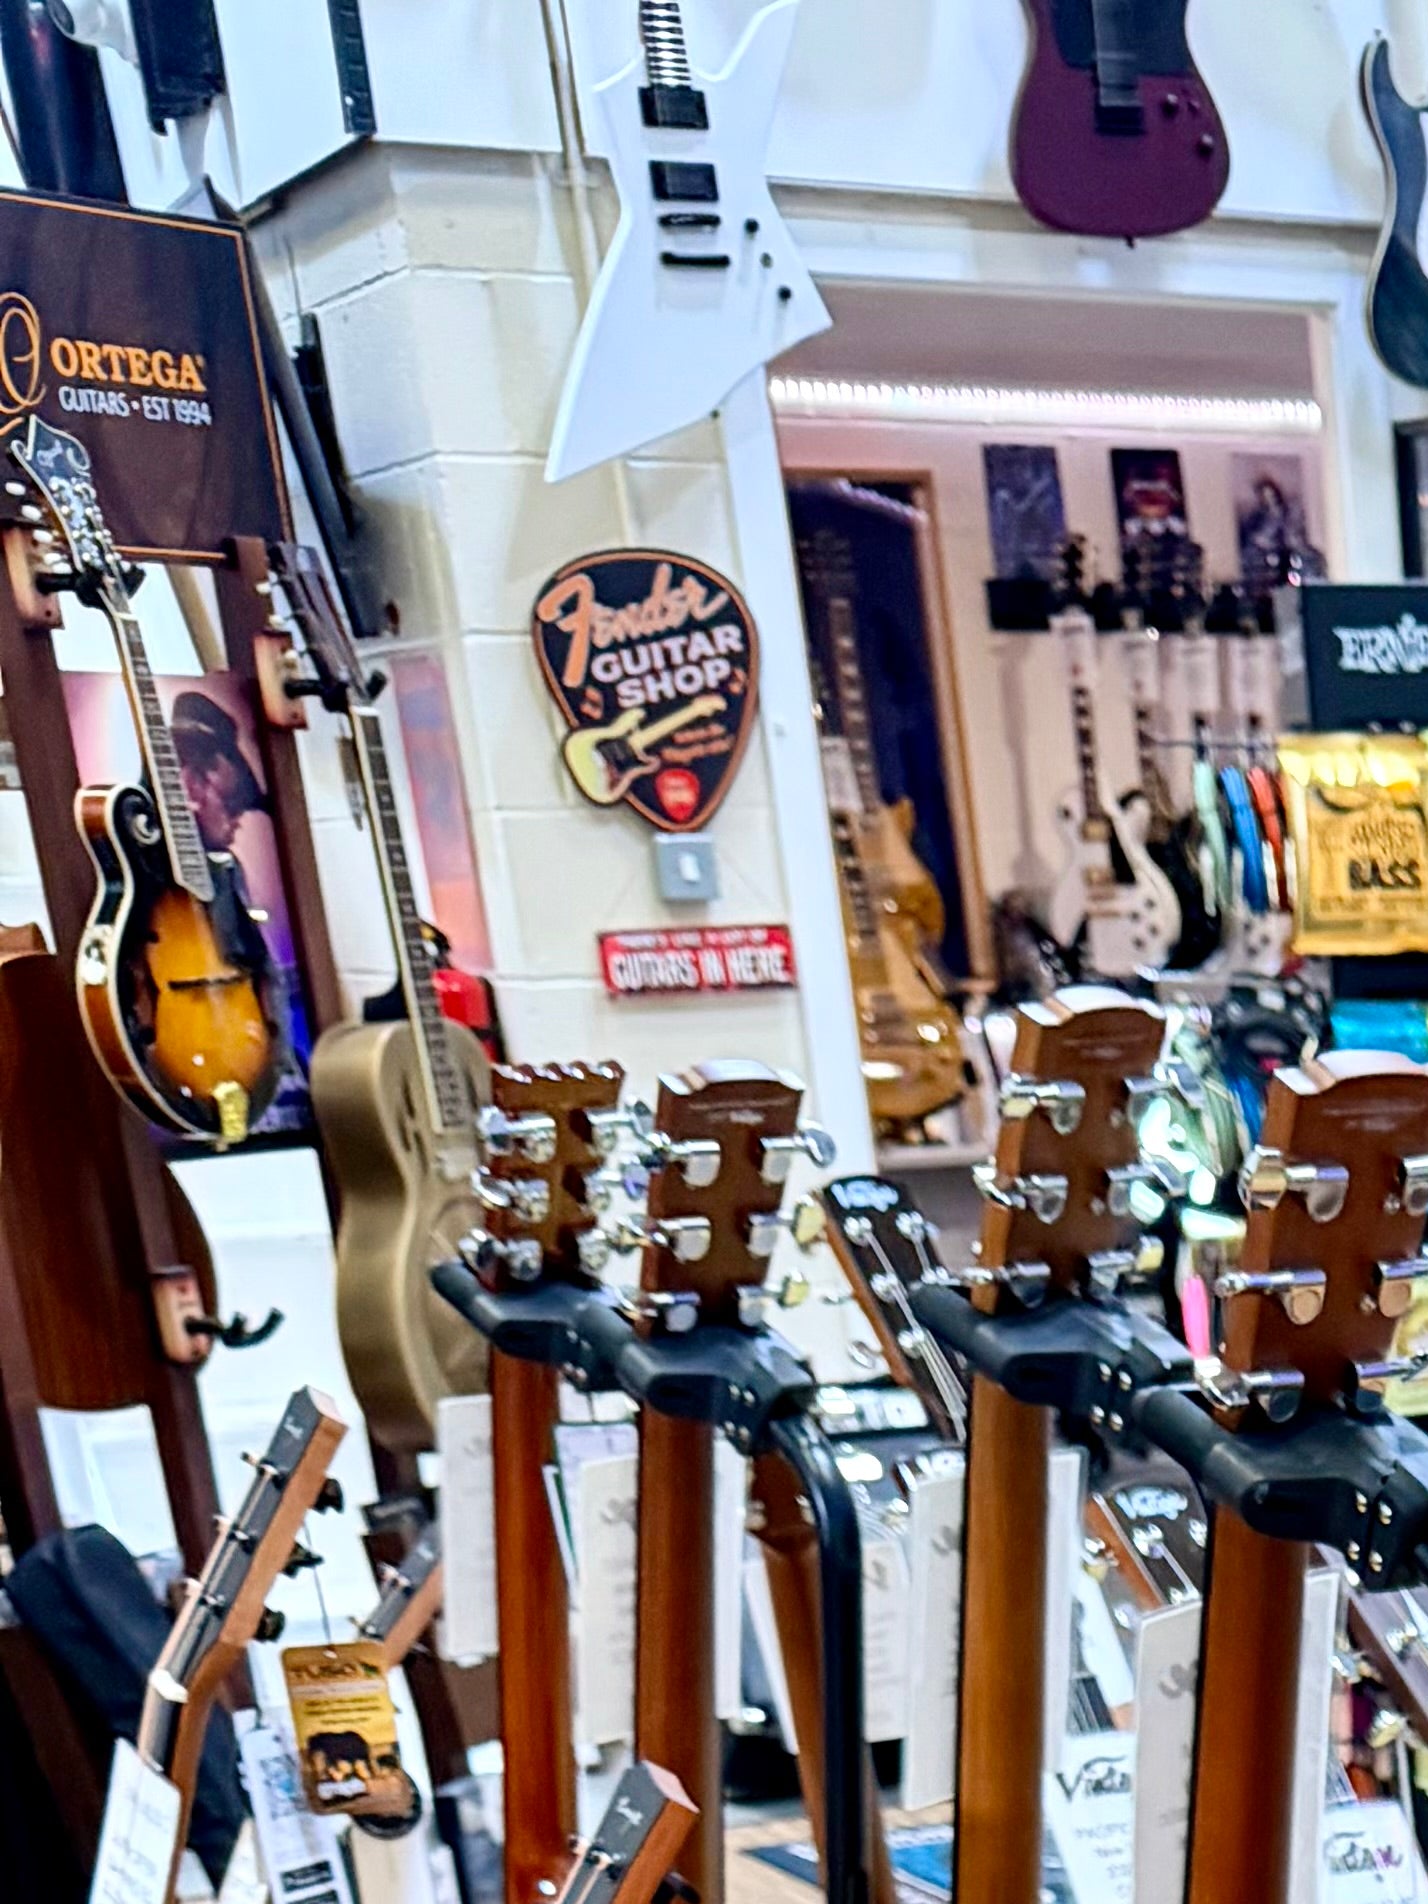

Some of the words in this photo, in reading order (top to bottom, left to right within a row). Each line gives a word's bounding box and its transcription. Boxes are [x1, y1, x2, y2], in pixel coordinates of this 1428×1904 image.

[51, 337, 207, 392] ORTEGA
[58, 386, 131, 418] GUITARS
[141, 395, 171, 422] EST
[537, 562, 730, 689] Fender
[590, 623, 745, 684] GUITAR
[616, 656, 732, 710] SHOP
[1348, 856, 1423, 891] BASS
